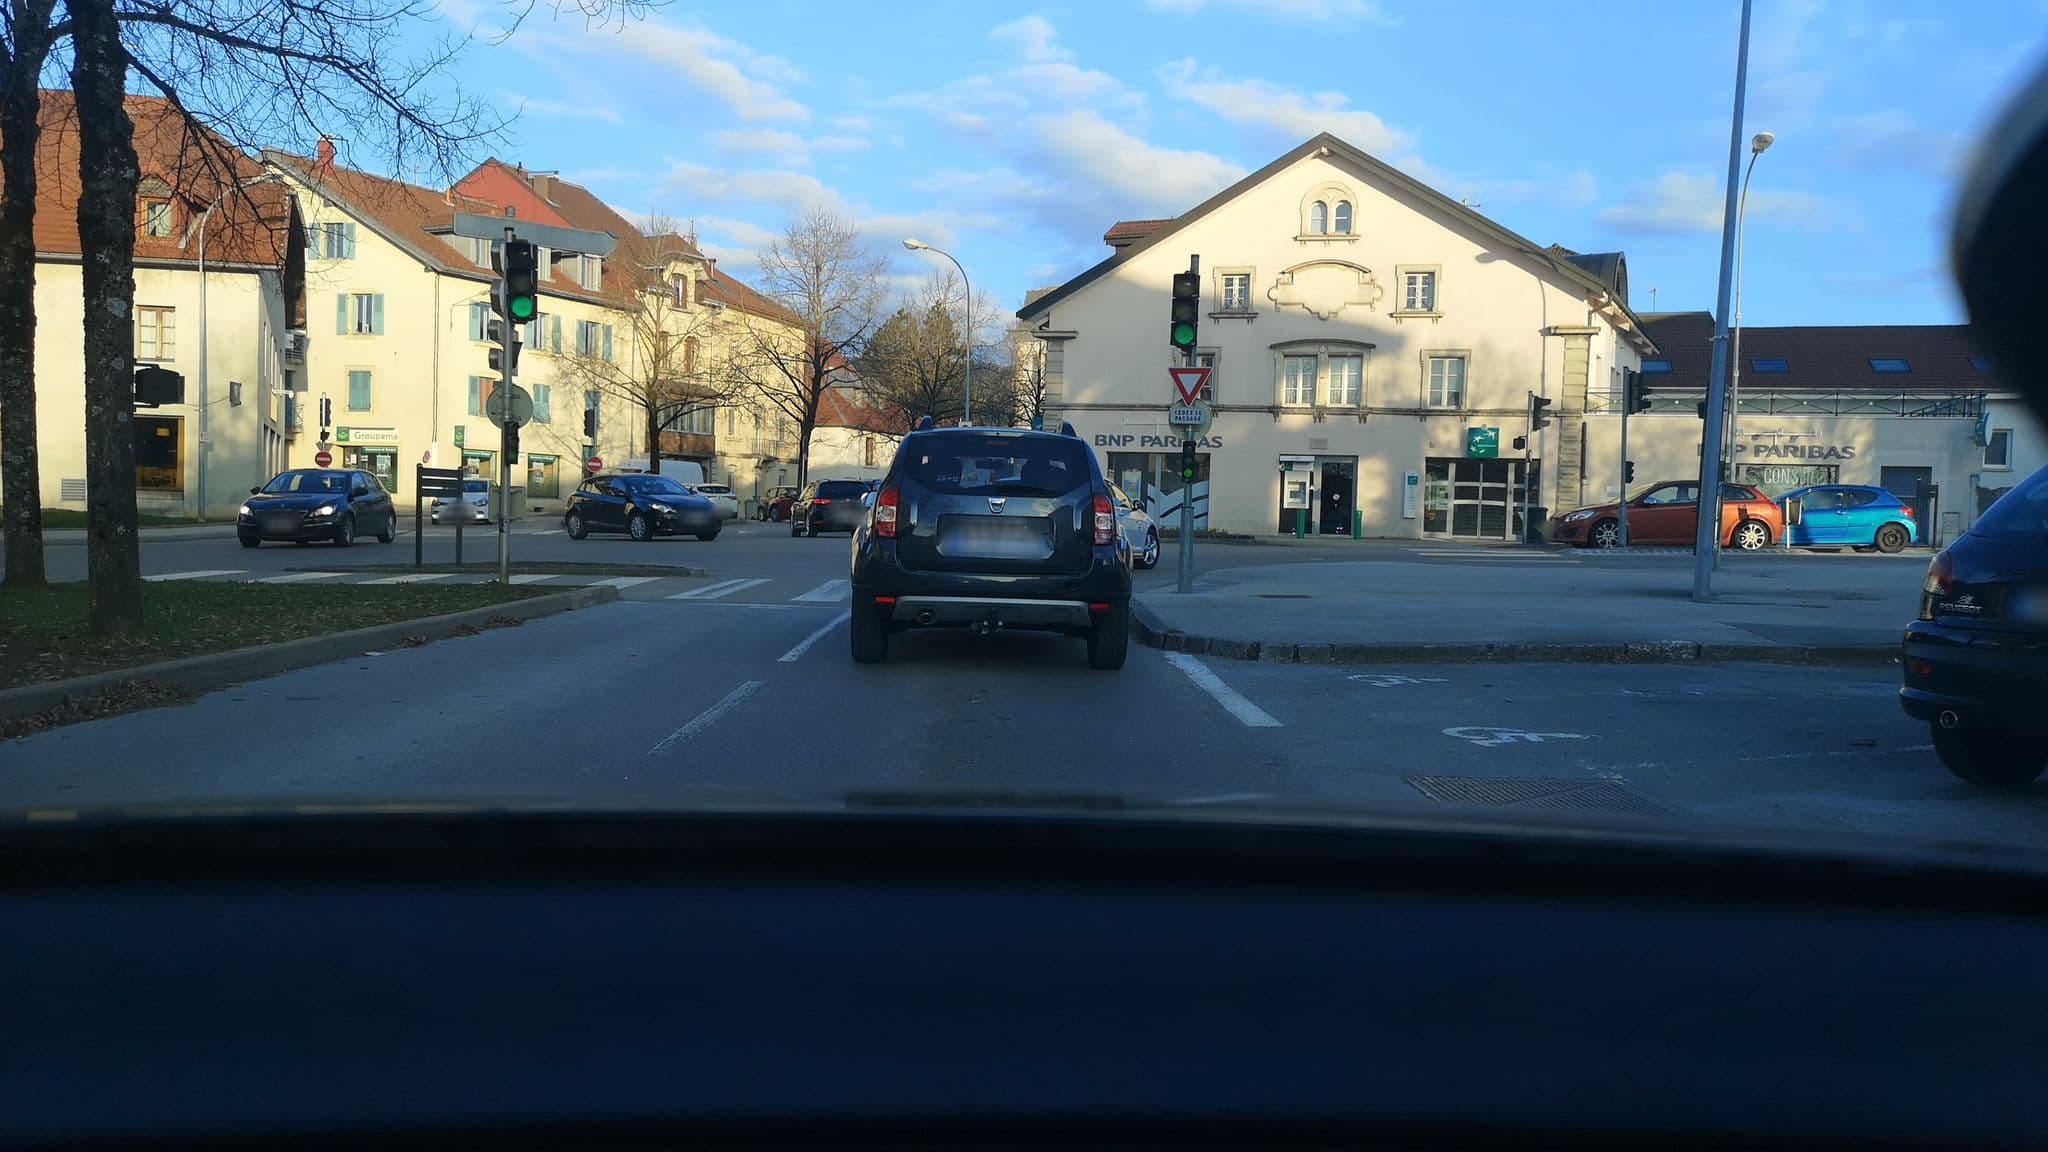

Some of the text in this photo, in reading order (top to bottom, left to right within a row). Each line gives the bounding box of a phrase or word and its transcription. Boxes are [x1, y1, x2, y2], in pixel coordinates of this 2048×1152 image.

[354, 431, 399, 441] Groupama
[1094, 434, 1223, 448] BNP PARIAS
[1753, 444, 1856, 460] PARIBAS
[1938, 602, 1982, 613] PEUGEOT
